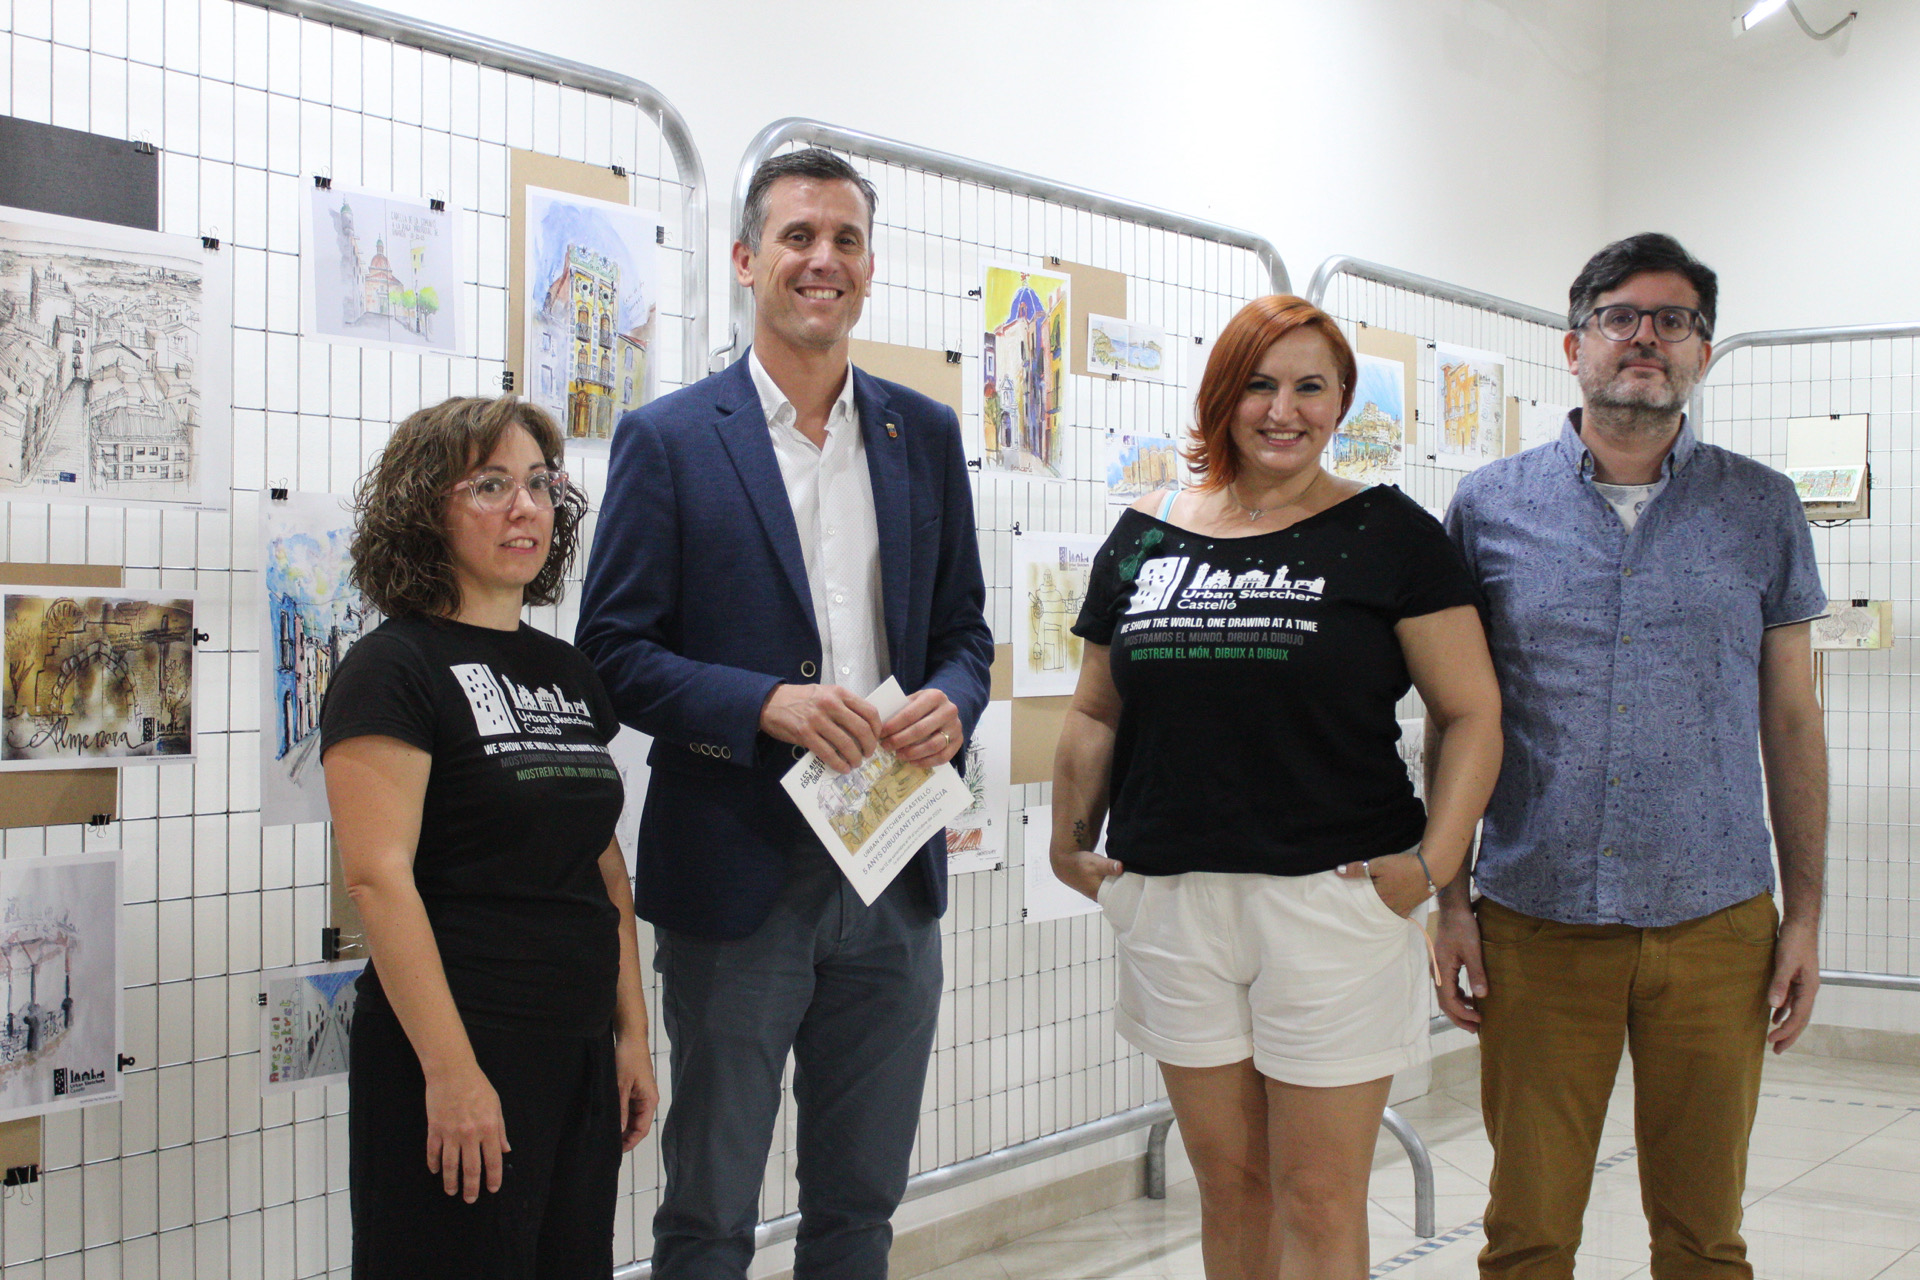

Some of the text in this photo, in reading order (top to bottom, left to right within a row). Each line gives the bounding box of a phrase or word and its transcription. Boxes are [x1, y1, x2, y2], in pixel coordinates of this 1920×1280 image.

[1181, 590, 1322, 601] Urban Sketchers
[1177, 599, 1238, 610] Castelló
[1129, 619, 1152, 631] SHOW
[1152, 617, 1170, 628] THE
[1170, 617, 1205, 629] WORLD,
[1206, 617, 1227, 628] ONE
[1227, 617, 1271, 628] DRAWING
[1271, 617, 1285, 628] AT
[1285, 618, 1293, 629] A
[1294, 619, 1319, 632] TIME
[1124, 632, 1304, 647] MOSTRAMOS EL MUNDO, DIBUJO A DIBUJO
[1131, 647, 1173, 661] MOSTREM
[1175, 647, 1187, 659] EL
[1215, 647, 1246, 659] DIBUIX
[1248, 647, 1255, 659] A
[1257, 647, 1289, 661] DIBUIX
[515, 709, 552, 724] Urban
[6, 716, 150, 756] Almenara
[523, 722, 562, 736] Castelló
[484, 743, 500, 756] WE
[498, 741, 522, 753] SHOW
[520, 741, 537, 750] THE
[516, 766, 555, 781] MOSTREM
[554, 766, 565, 777] EL
[863, 840, 880, 858] URBAN
[879, 811, 905, 841] SKETCHERS
[867, 852, 883, 870] ANYS
[881, 819, 912, 854] DIBUIXANT
[911, 788, 948, 822] PROVÍNCIA
